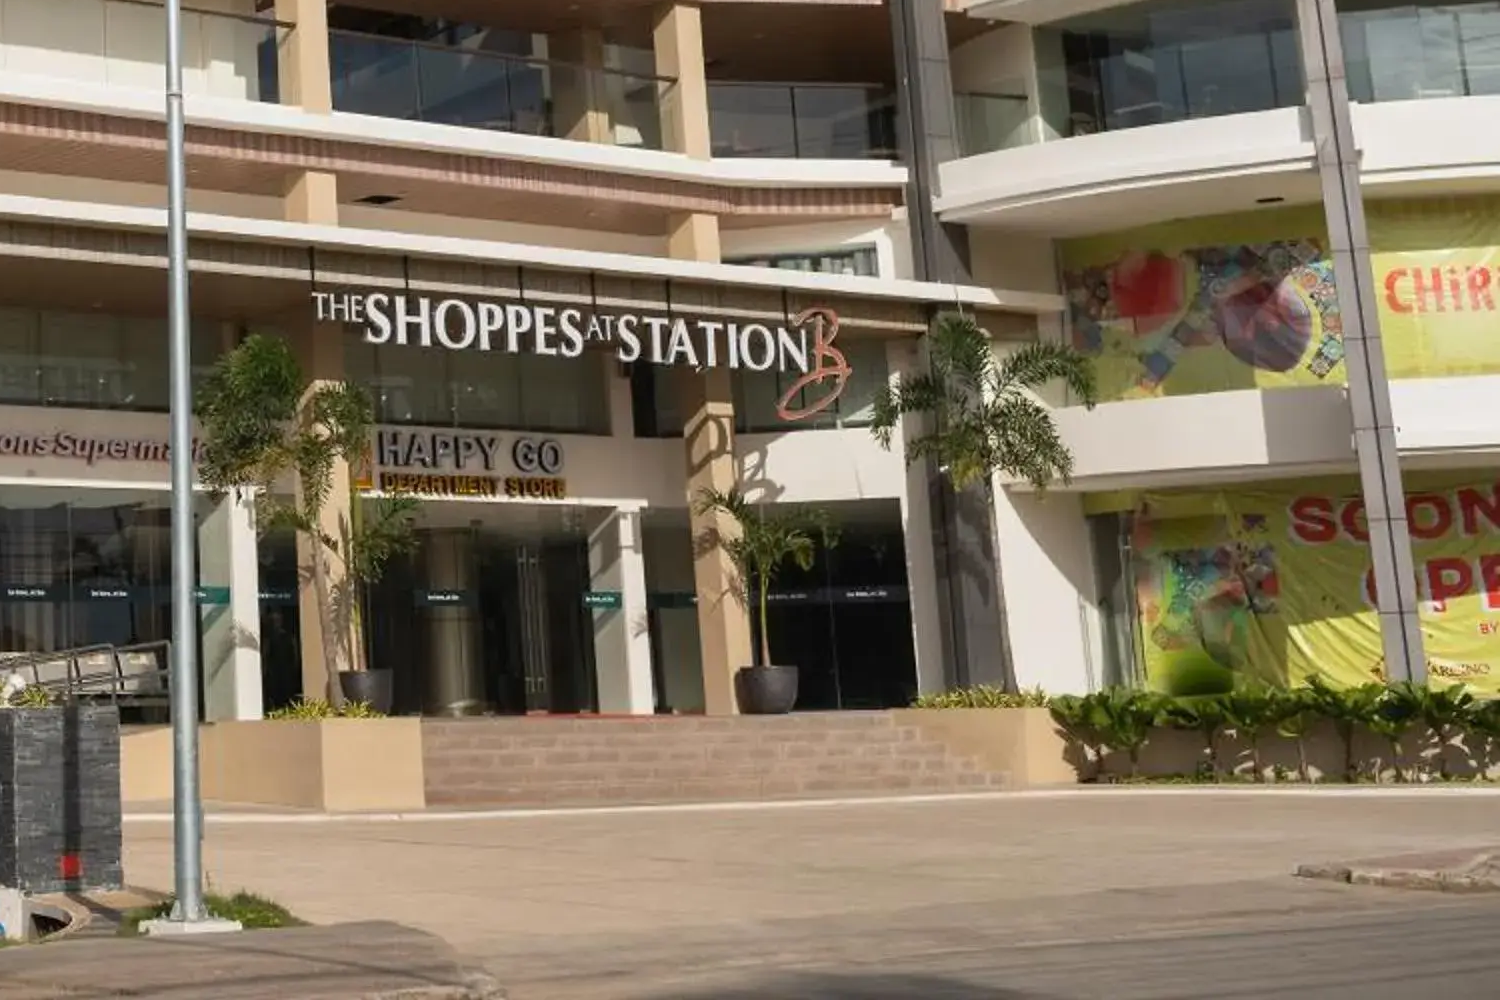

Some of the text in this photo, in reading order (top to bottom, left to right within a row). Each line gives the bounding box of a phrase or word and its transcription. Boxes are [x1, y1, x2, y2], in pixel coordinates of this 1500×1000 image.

[1384, 265, 1500, 314] CHiR
[312, 292, 852, 421] THE SHOPPES AT STATION B
[377, 432, 564, 474] HAPPY GO
[380, 472, 566, 498] DEPARTMENT STORE
